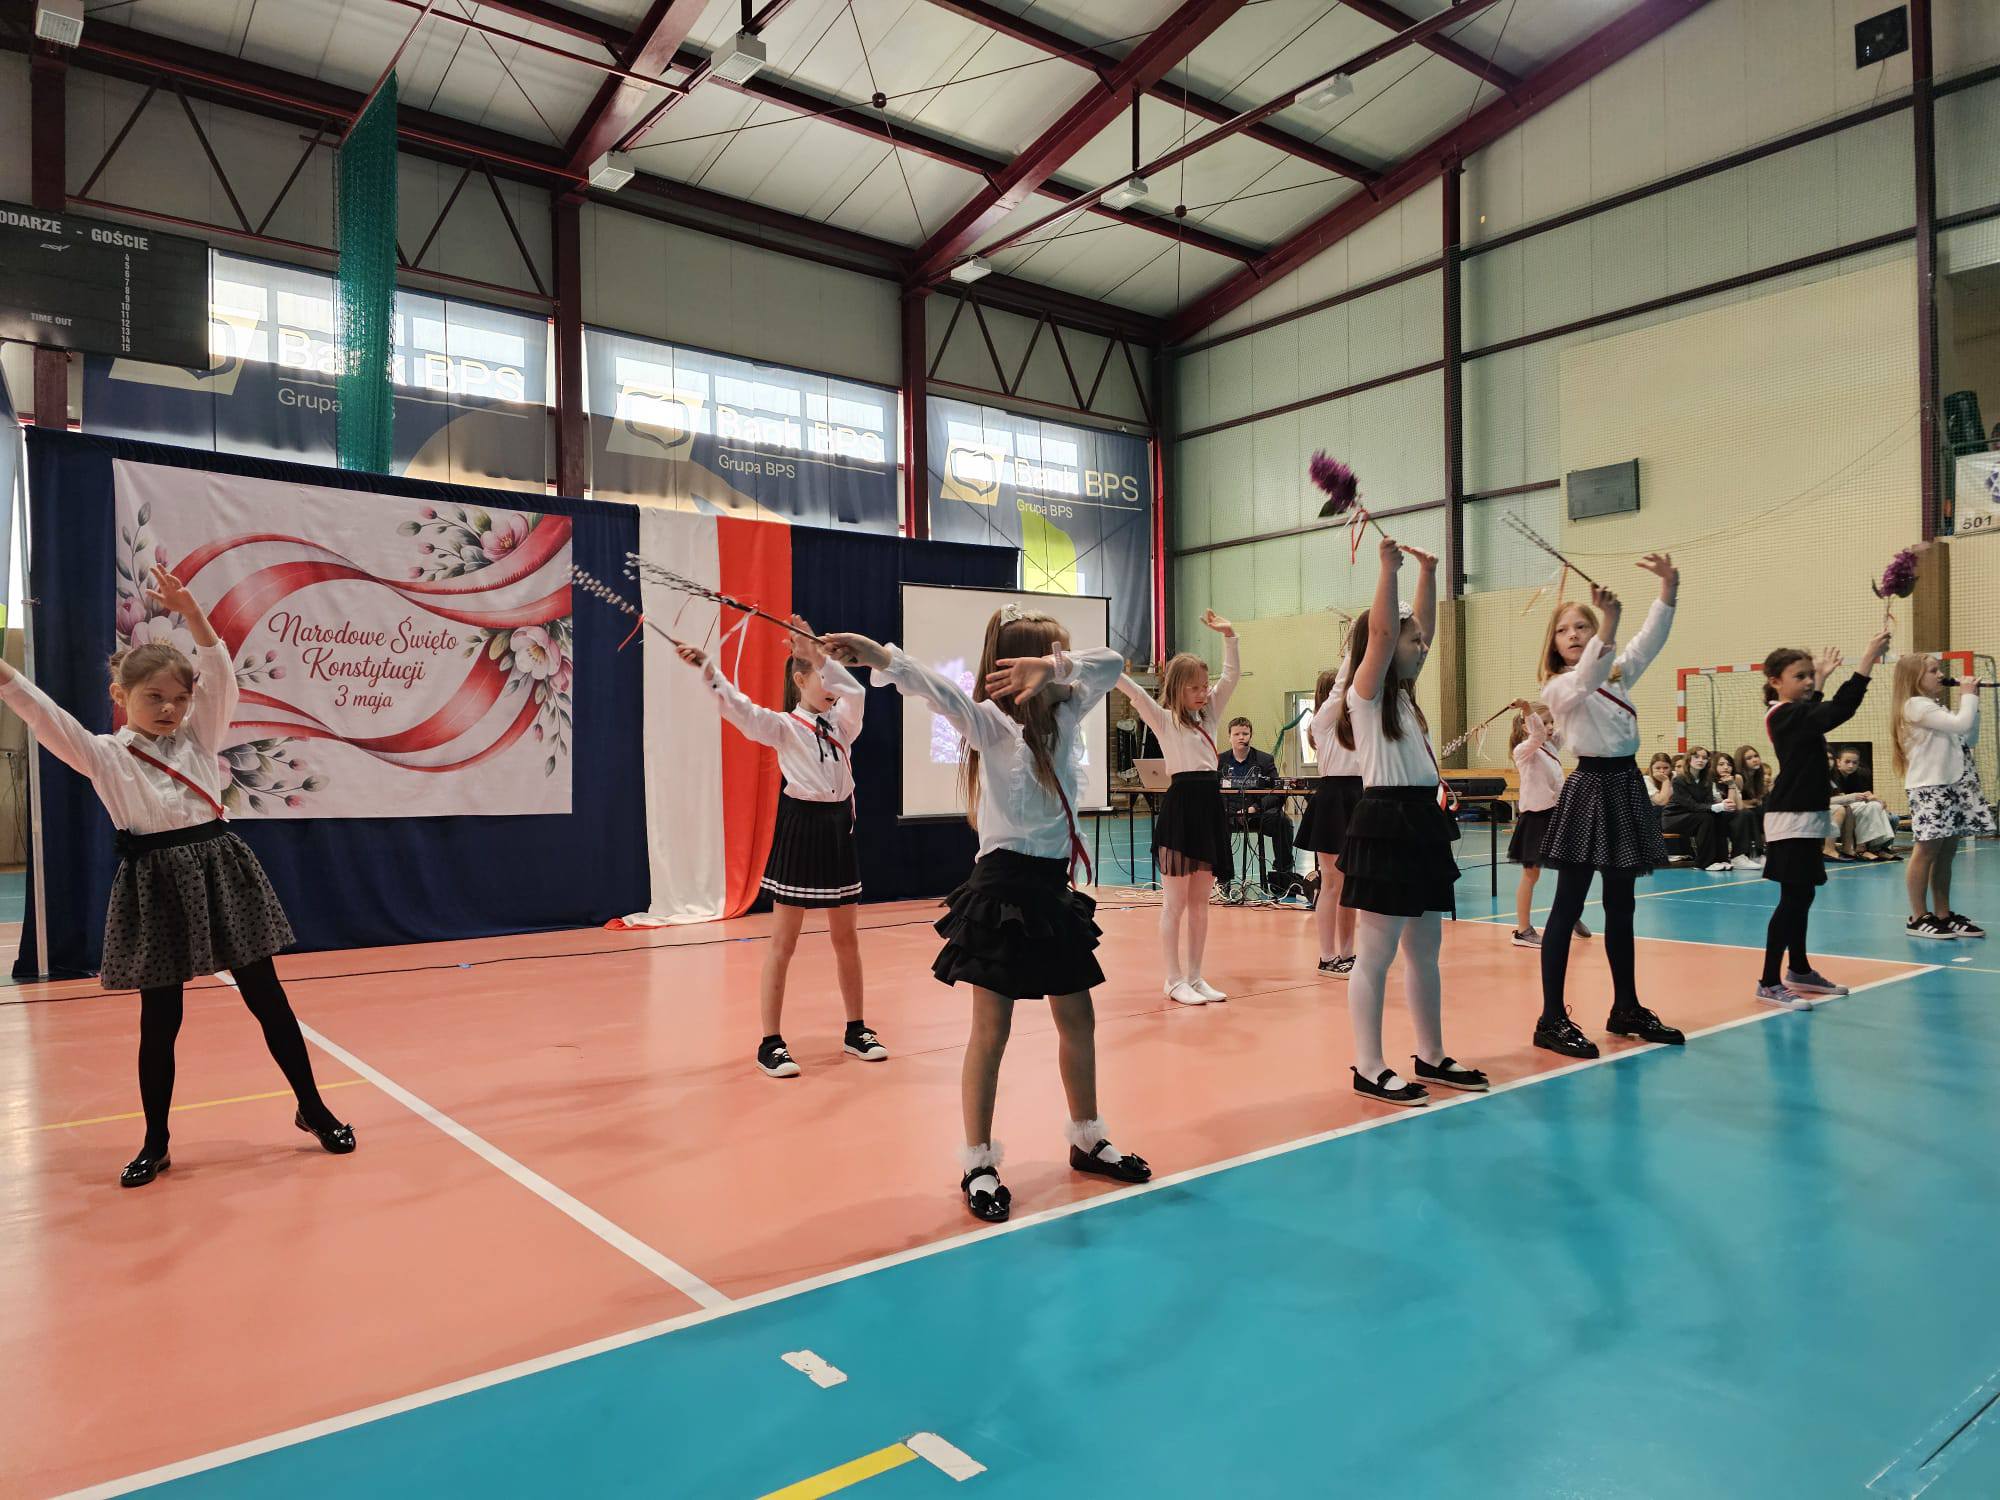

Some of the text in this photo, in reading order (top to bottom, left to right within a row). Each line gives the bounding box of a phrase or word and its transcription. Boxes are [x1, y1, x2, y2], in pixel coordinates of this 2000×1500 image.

[91, 228, 149, 250] GOŚCIE
[124, 262, 130, 270] 5
[124, 270, 130, 278] 6
[124, 278, 130, 286] 7
[124, 286, 130, 294] 8
[124, 294, 130, 303] 9
[121, 302, 130, 311] 10
[121, 310, 130, 319] 11
[31, 312, 72, 327] TIME OUT
[121, 319, 130, 327] 12
[121, 327, 130, 336] 13
[121, 335, 130, 344] 14
[121, 343, 130, 352] 15
[425, 353, 526, 404] BPS
[718, 455, 796, 479] Grupa BPS
[1084, 470, 1139, 502] BPS
[1016, 499, 1073, 518] Grupa BPS
[1962, 515, 1992, 530] 501
[268, 611, 459, 655] Narodowe Święto
[302, 647, 426, 689] Konstytucji
[335, 685, 393, 714] 3 maja
